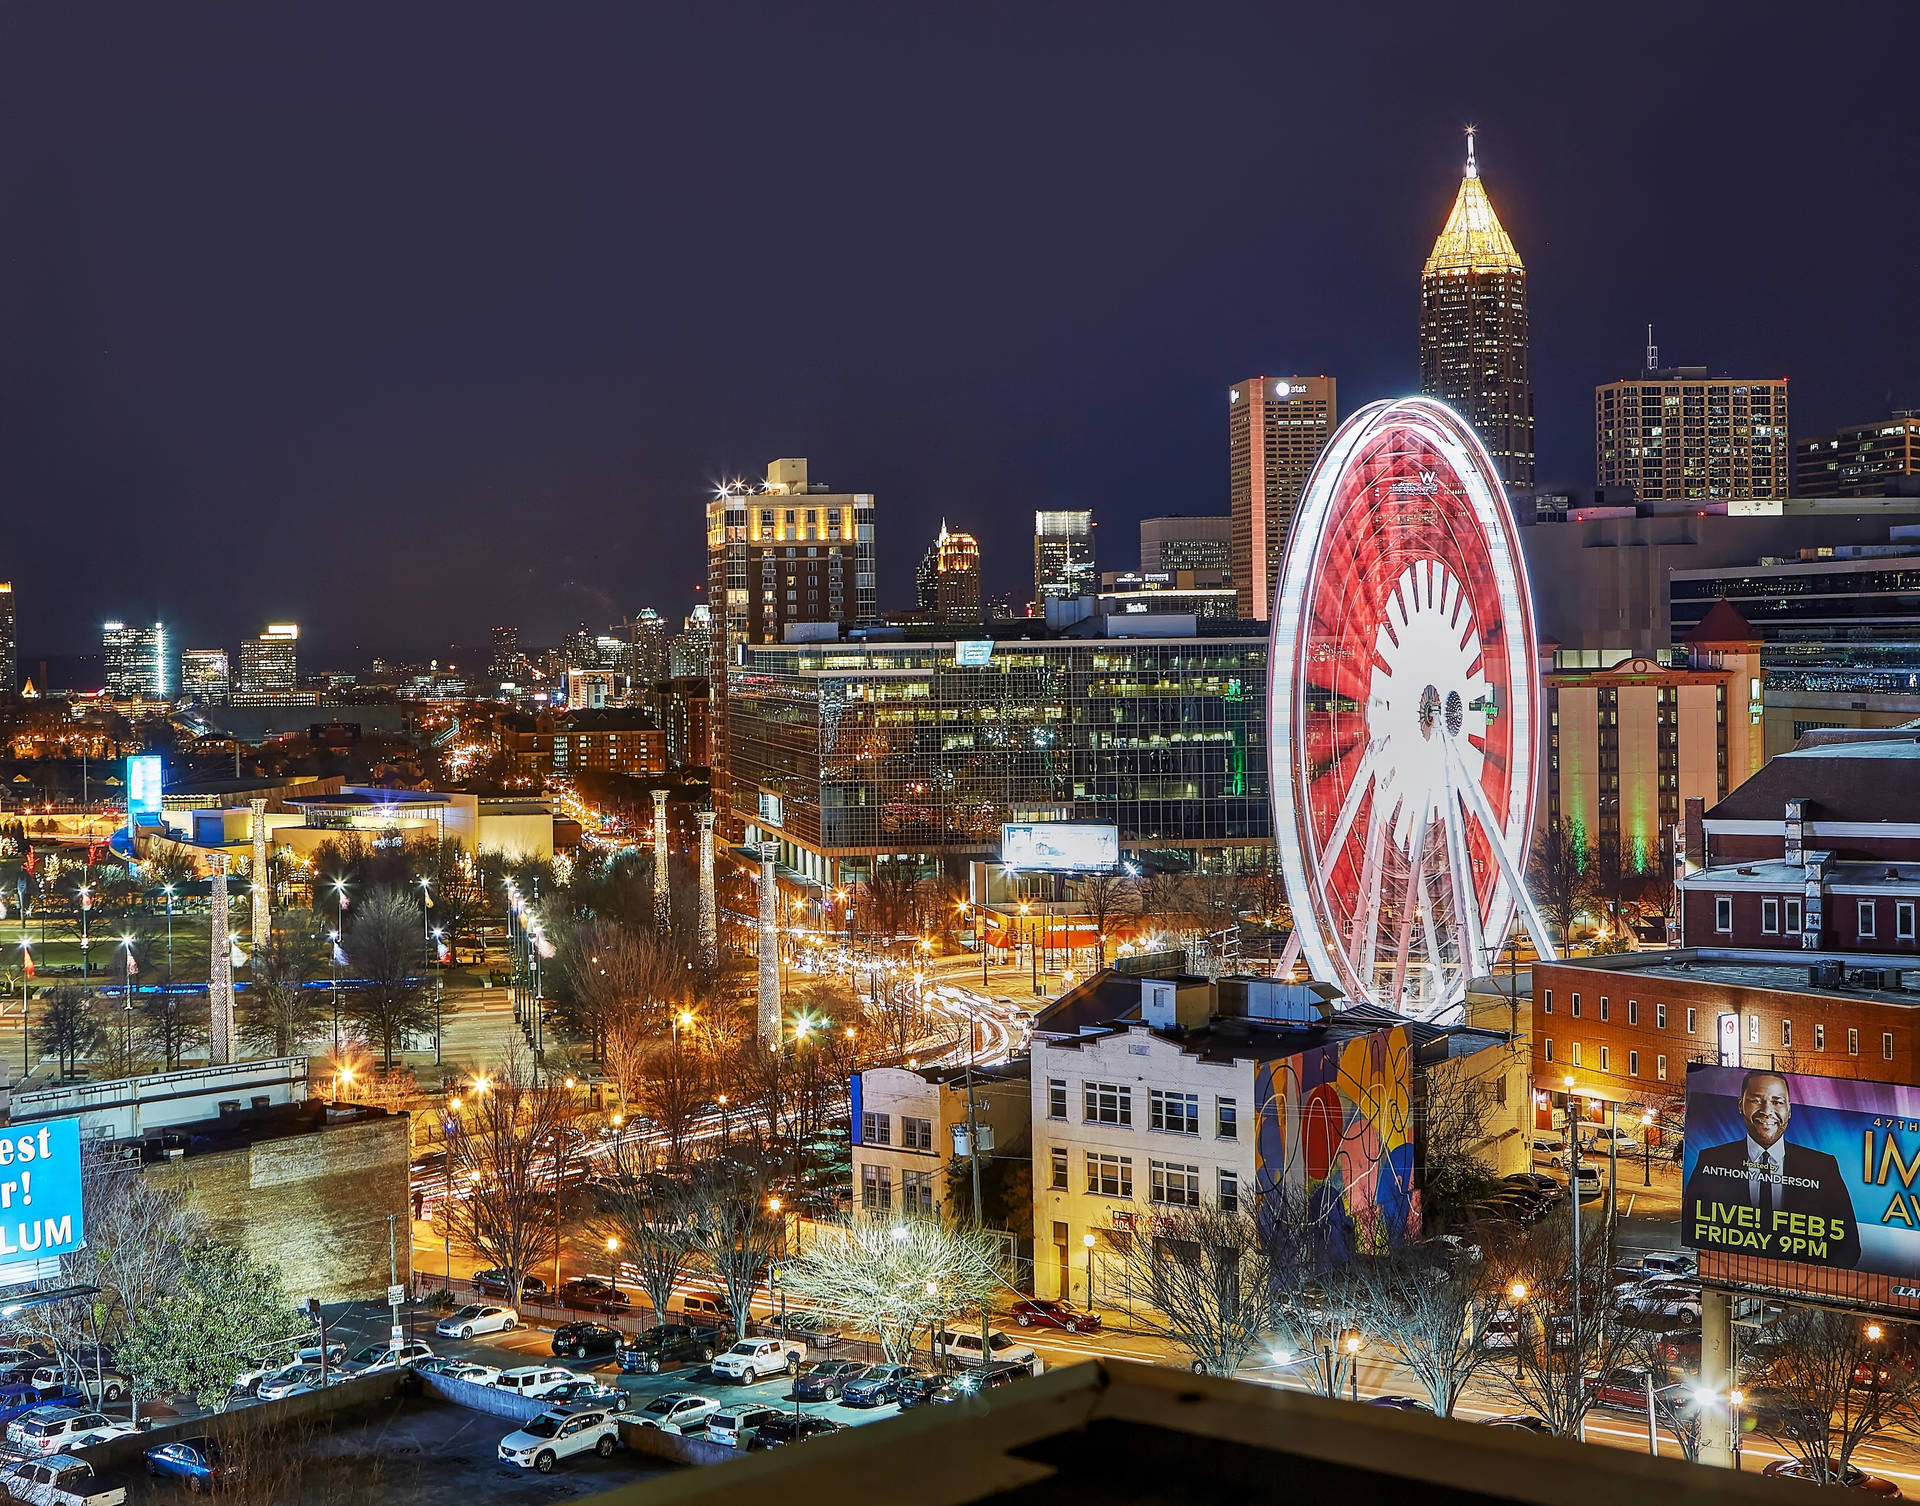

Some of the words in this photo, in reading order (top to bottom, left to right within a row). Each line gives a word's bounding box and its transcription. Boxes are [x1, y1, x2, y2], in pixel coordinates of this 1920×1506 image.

[1873, 1118, 1918, 1132] 47TH
[1743, 1159, 1768, 1171] Hosted
[1769, 1164, 1779, 1173] by
[1702, 1165, 1757, 1181] ANTHONY
[1756, 1172, 1820, 1189] ANDERSON
[1695, 1200, 1761, 1229] LIVE!
[1772, 1210, 1825, 1237] FEB
[1829, 1220, 1845, 1240] 5
[1695, 1223, 1773, 1250] FRIDAY
[1779, 1236, 1828, 1259] 9PM
[1898, 1286, 1920, 1299] LA
